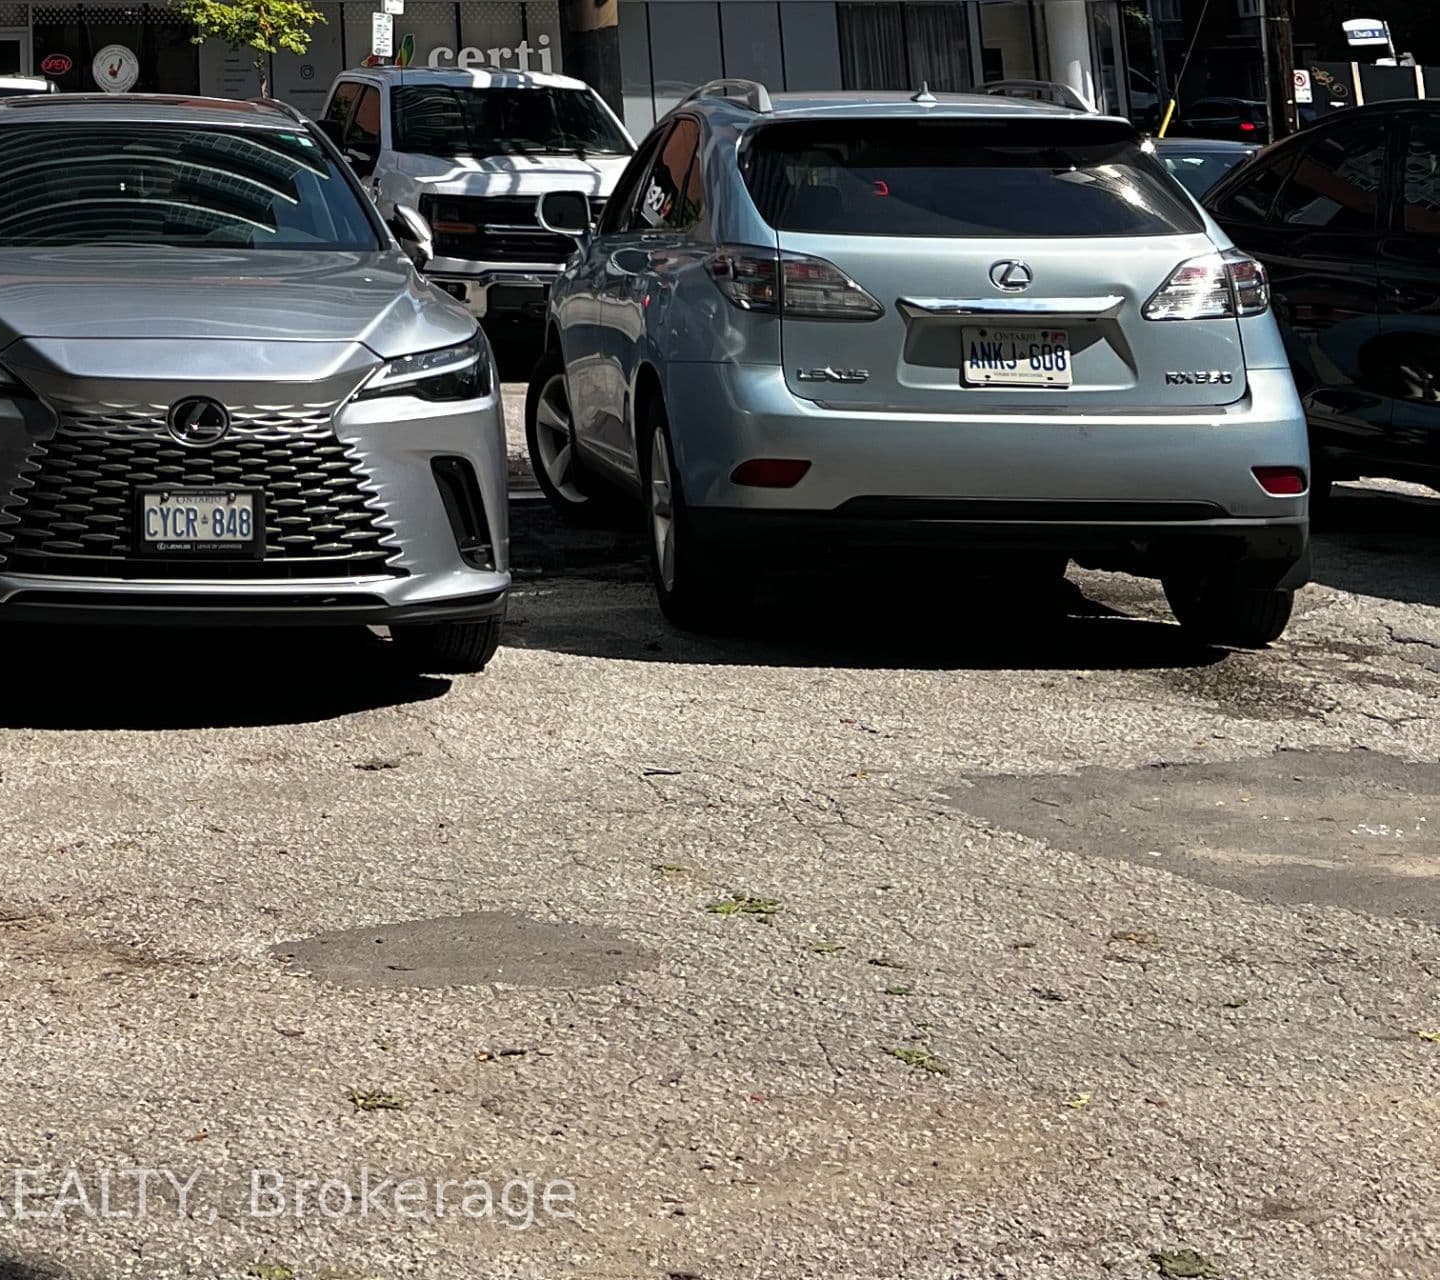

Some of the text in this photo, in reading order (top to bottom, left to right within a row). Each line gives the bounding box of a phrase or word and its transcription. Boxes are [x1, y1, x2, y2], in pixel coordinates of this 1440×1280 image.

[428, 34, 552, 75] certi
[969, 341, 1067, 372] ANKJ 608
[797, 367, 869, 384] LEXUS
[145, 507, 251, 538] CYCR 848
